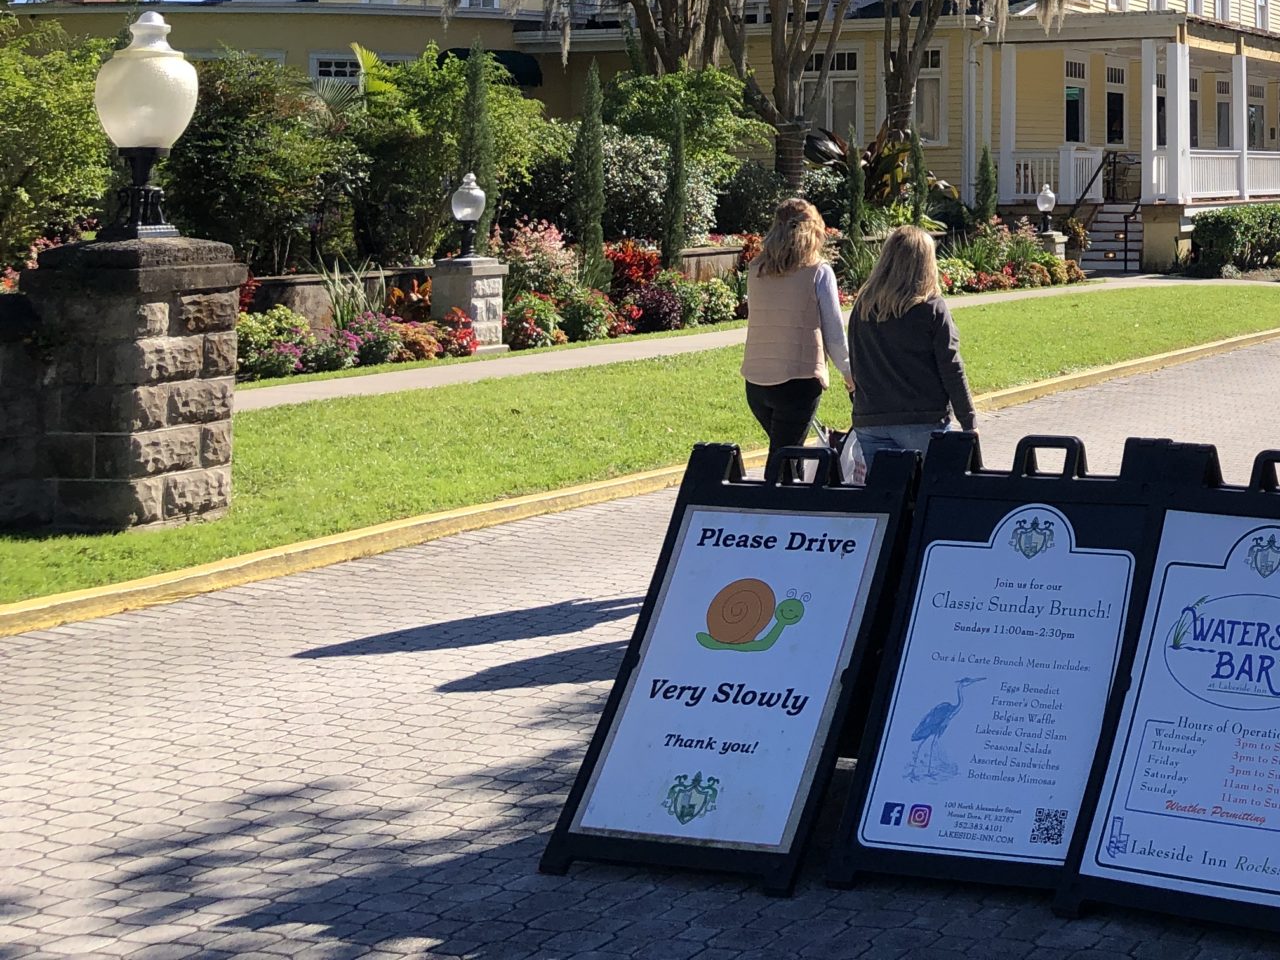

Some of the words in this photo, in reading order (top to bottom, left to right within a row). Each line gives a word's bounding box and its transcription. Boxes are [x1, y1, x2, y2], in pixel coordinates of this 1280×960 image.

[697, 528, 777, 550] Please
[785, 531, 856, 555] Drive
[994, 577, 1014, 590] Join
[1016, 581, 1027, 590] us
[1029, 578, 1044, 590] for
[1046, 583, 1063, 591] our
[931, 592, 984, 612] Classic
[987, 596, 1045, 618] Sunday
[1049, 600, 1112, 619] Brunch!
[953, 622, 991, 634] Sundays
[993, 625, 1075, 640] 11:00am-2:30pm
[931, 651, 949, 662] Our
[958, 652, 966, 663] la
[968, 654, 991, 665] Carte
[993, 656, 1024, 667] Brunch
[1026, 658, 1050, 669] Menu
[1053, 660, 1091, 672] Includes:
[1000, 681, 1020, 693] Eggs
[1022, 684, 1060, 695] Benedict
[649, 679, 706, 707] Very
[712, 682, 809, 716] Slowly
[991, 696, 1028, 708] Farmer's
[1030, 699, 1063, 711] Omelet
[993, 710, 1025, 724] Belgian
[1028, 713, 1056, 725] Waffle
[1177, 716, 1214, 732] Hours
[1216, 720, 1230, 733] of
[975, 724, 1013, 737] Lakeside
[1014, 727, 1043, 739] Grand
[1044, 729, 1067, 741] Slam
[1154, 728, 1208, 745] Wednesday
[664, 733, 716, 751] Thank
[720, 739, 759, 755] you!
[983, 740, 1022, 753] Seasonal
[1023, 743, 1052, 755] Salads
[1152, 741, 1198, 756] Thursday
[1234, 738, 1258, 750] 3pm
[1260, 740, 1271, 750] to
[969, 754, 1008, 768] Assorted
[1009, 757, 1060, 771] Sandwiches
[1147, 754, 1180, 768] Friday
[1232, 751, 1255, 764] 3pm
[1258, 754, 1268, 764] to
[967, 769, 1015, 783] Bottomless
[1016, 773, 1057, 786] Mimosas
[1143, 768, 1189, 783] Saturday
[1228, 765, 1252, 777] 3pm
[1254, 768, 1265, 778] to
[1140, 782, 1178, 796] Sunday
[1223, 778, 1250, 791] 11am
[1252, 782, 1264, 792] to
[1221, 793, 1248, 805] 11am
[1250, 796, 1262, 806] to
[1165, 800, 1207, 815] Weather
[1210, 806, 1266, 826] Permitting
[938, 830, 1014, 844] LAKESIDE-INN.COM
[1130, 840, 1194, 863] Lakeside
[1201, 851, 1227, 869] Inn
